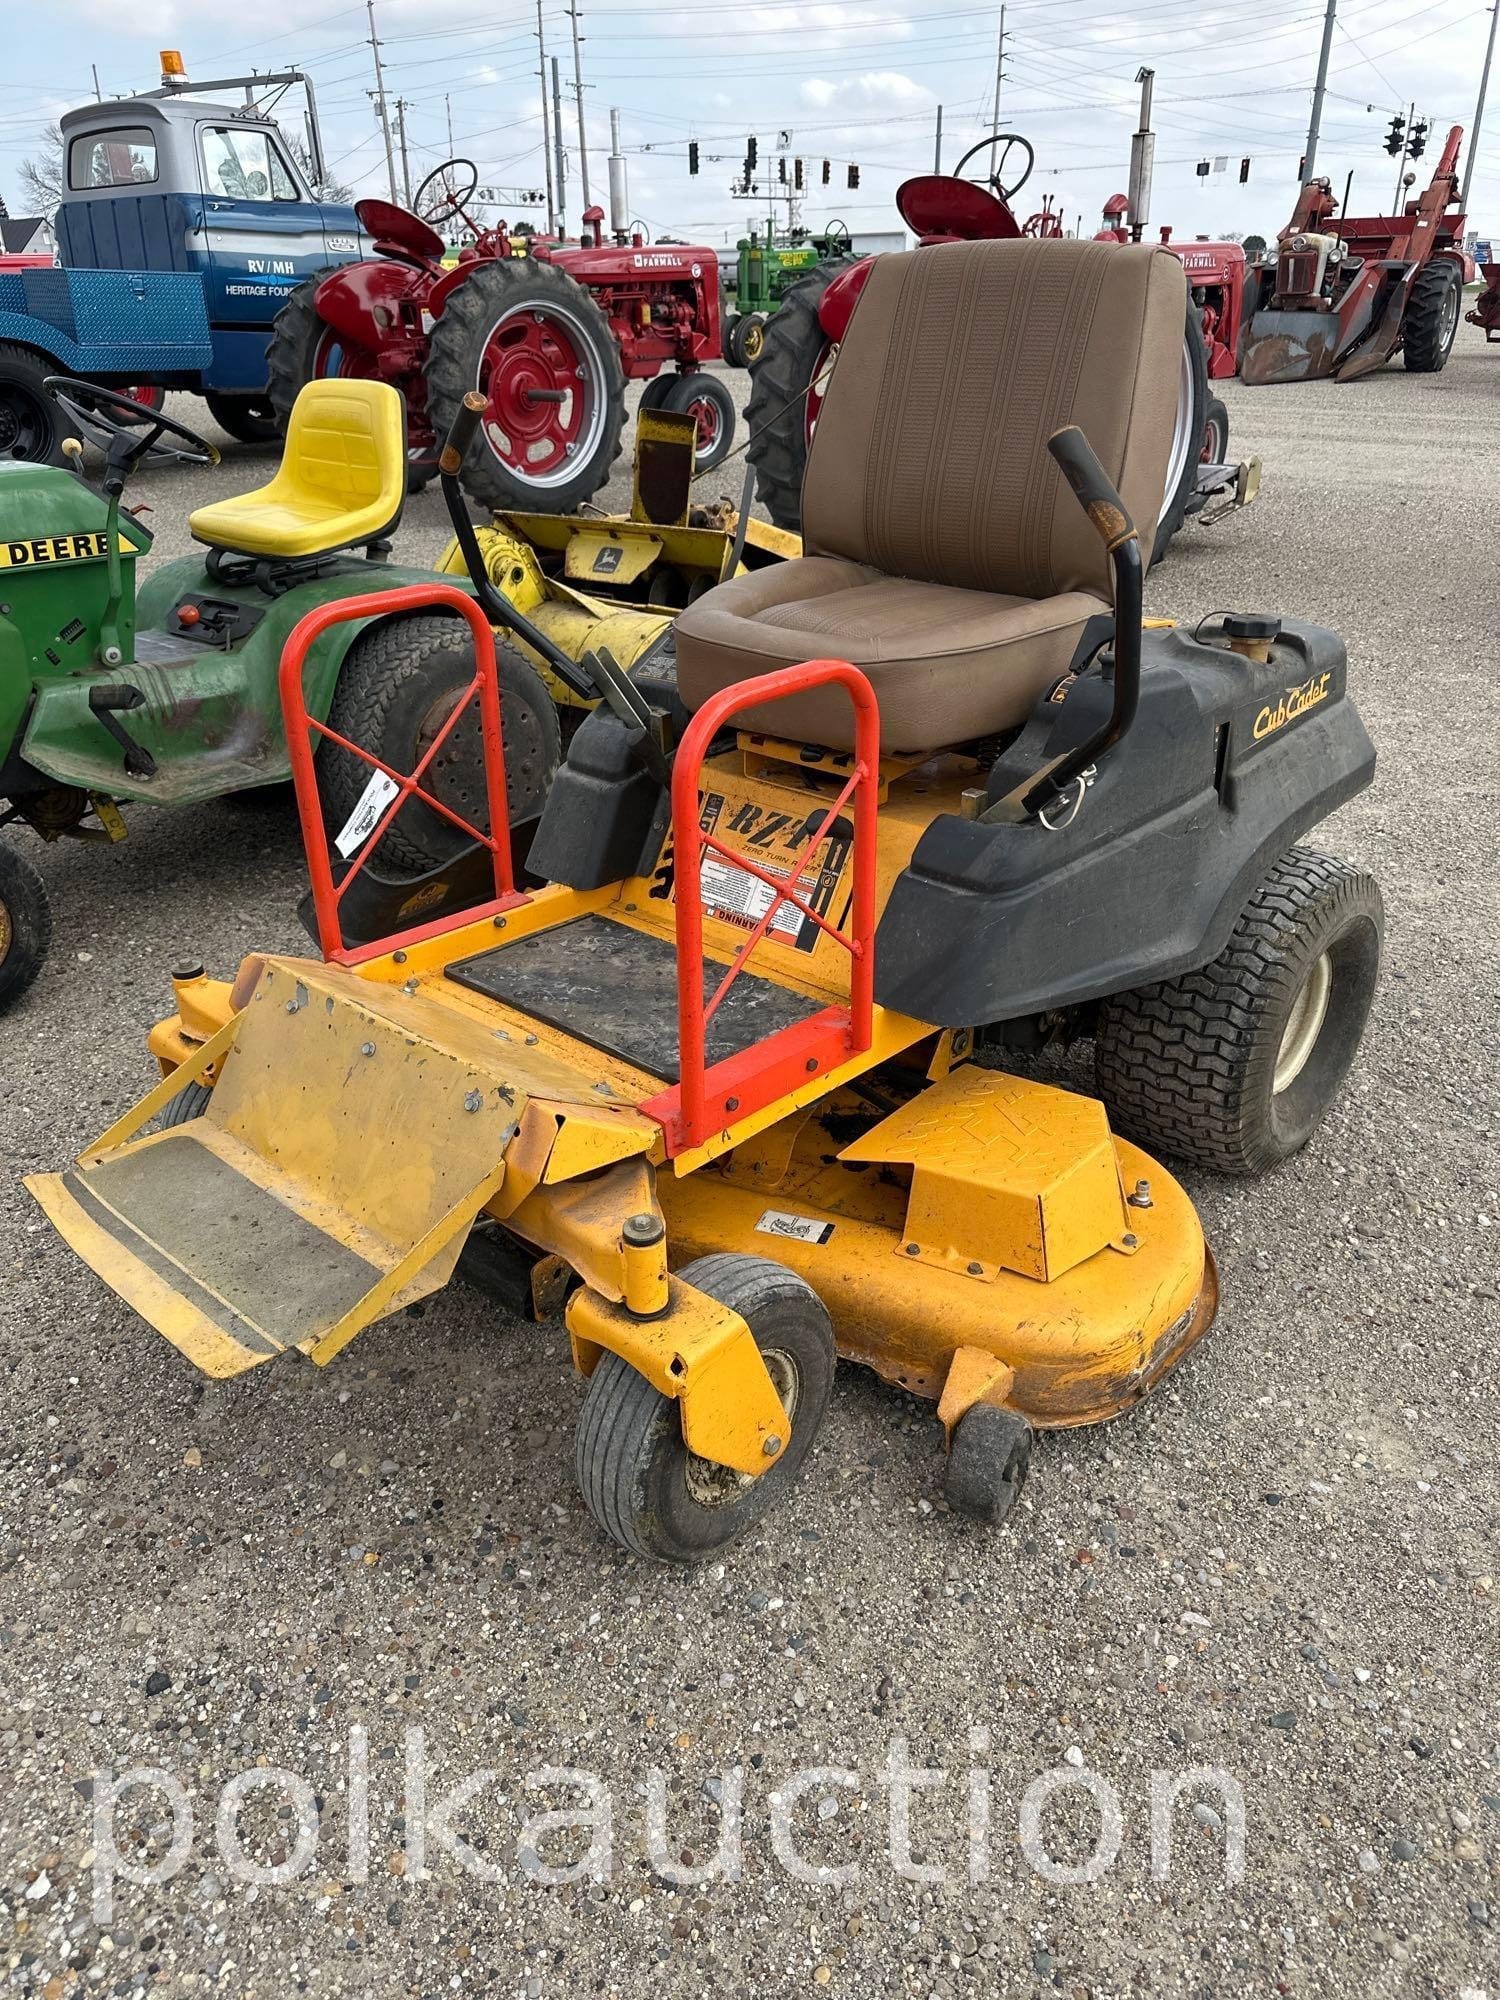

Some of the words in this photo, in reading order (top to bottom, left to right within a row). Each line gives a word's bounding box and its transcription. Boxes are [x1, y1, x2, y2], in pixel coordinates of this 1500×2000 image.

[643, 256, 682, 267] FARMALL
[1185, 257, 1216, 268] FARMALL
[226, 285, 267, 296] HERITAGE
[8, 533, 108, 565] DEERE
[1253, 698, 1286, 739] Cub
[1286, 672, 1331, 720] Cadet
[741, 844, 763, 856] ZERO
[766, 851, 790, 864] TURN
